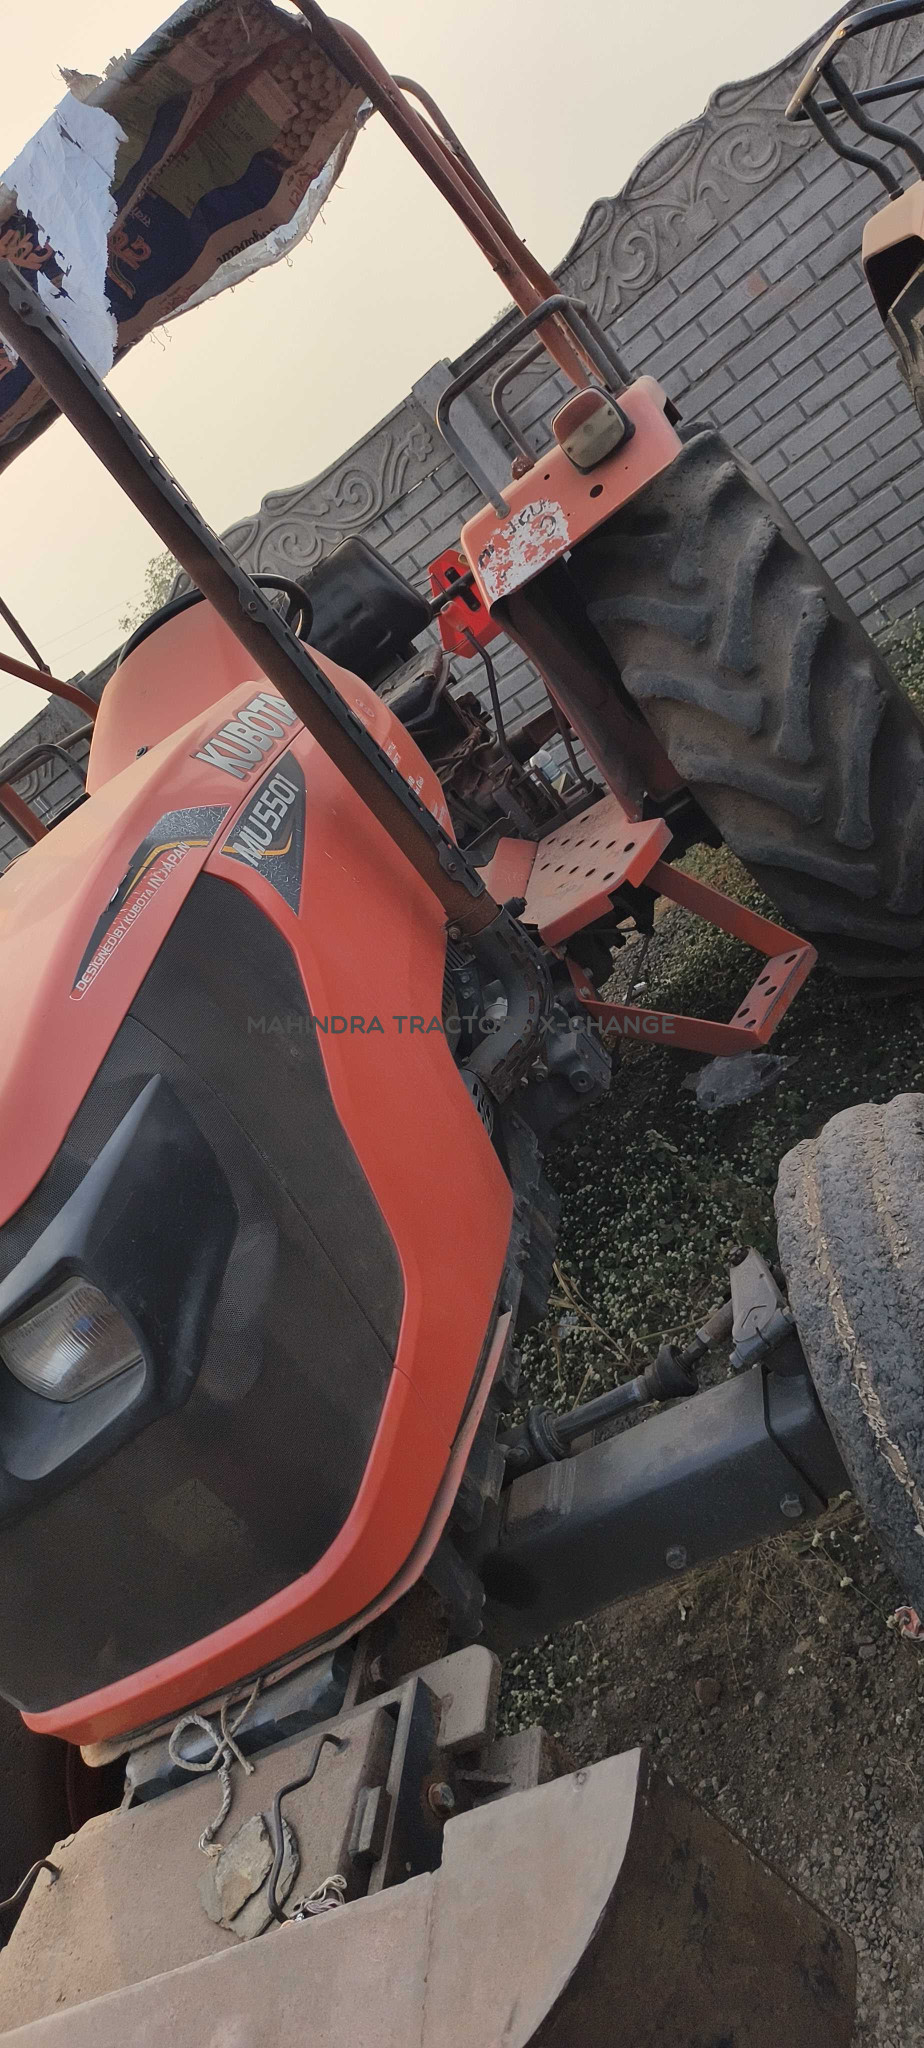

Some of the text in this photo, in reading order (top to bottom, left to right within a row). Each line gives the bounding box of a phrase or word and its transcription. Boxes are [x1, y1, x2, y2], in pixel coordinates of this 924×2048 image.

[196, 692, 298, 780] KUBOTA
[232, 773, 299, 867] MU5501
[75, 841, 191, 992] DESIGNED BY KUBOTA IN JAPAN
